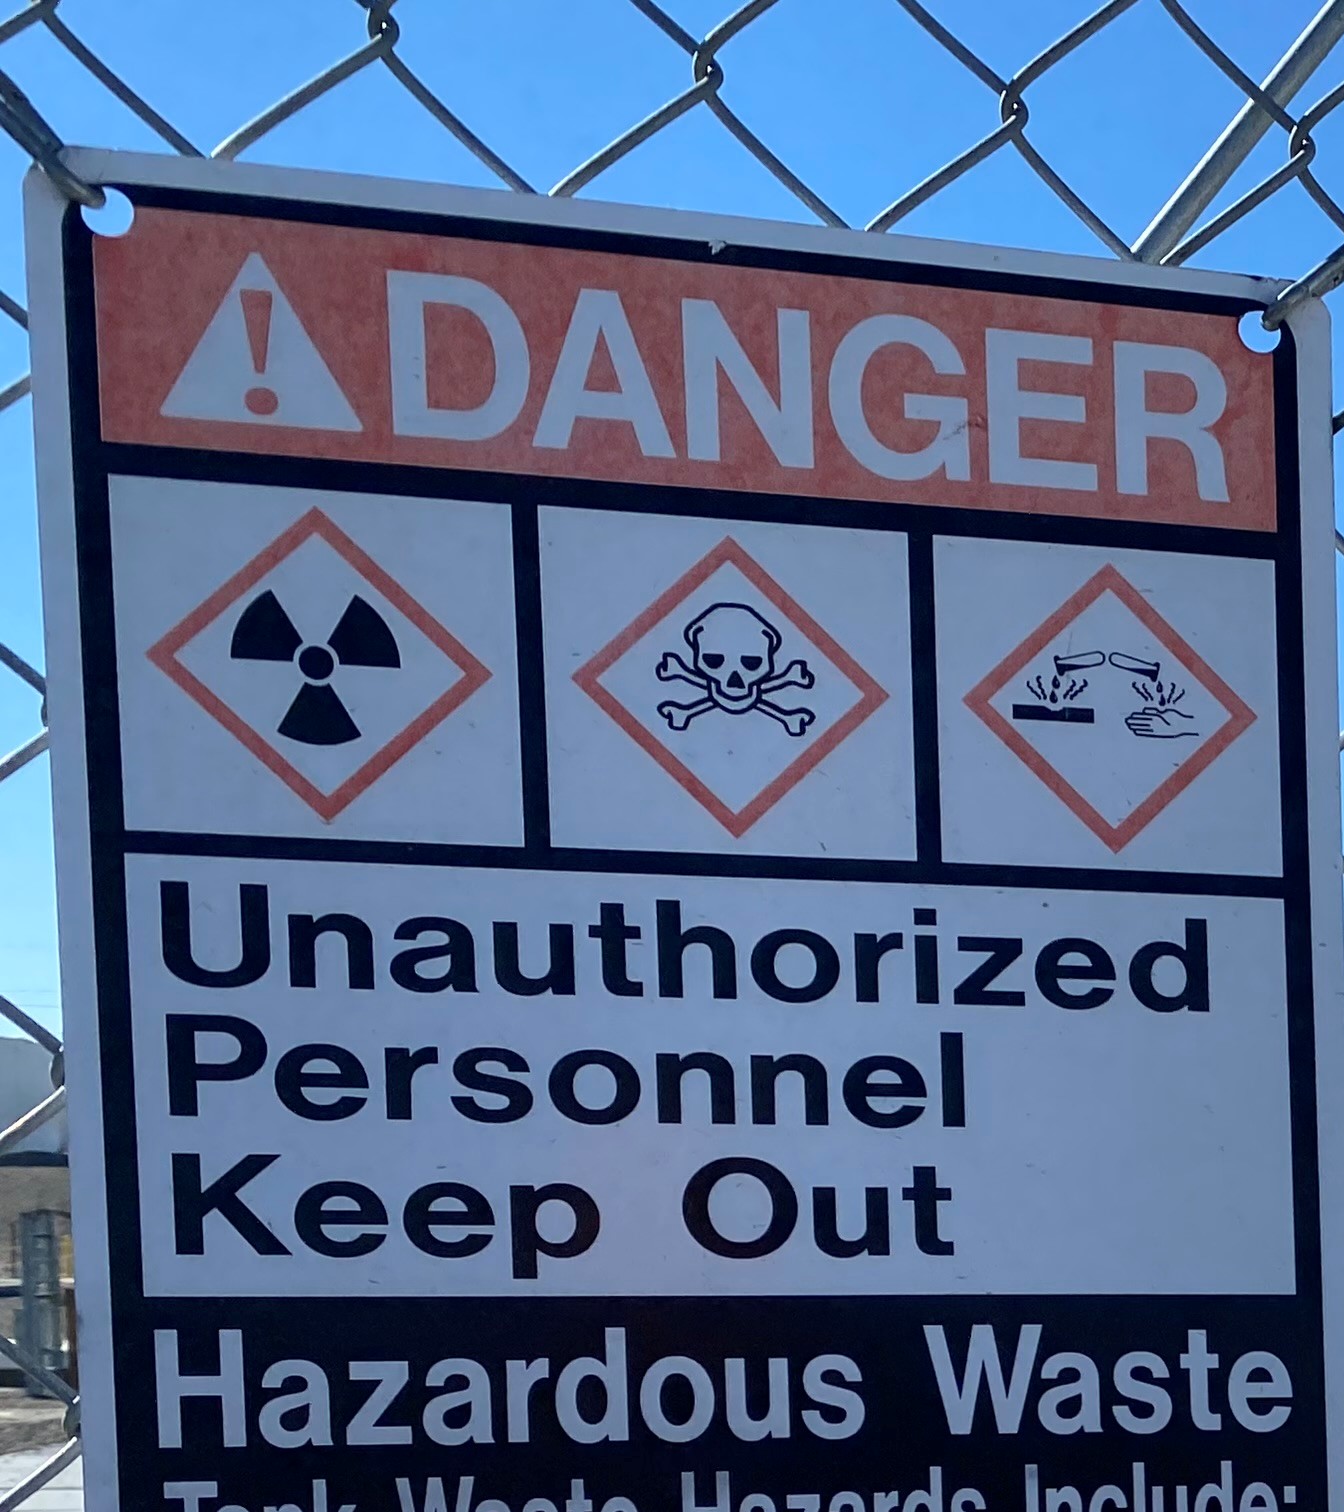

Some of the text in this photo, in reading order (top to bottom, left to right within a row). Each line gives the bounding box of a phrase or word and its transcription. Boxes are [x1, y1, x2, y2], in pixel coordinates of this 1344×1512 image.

[387, 270, 1230, 502] DANGER
[160, 881, 1209, 1012] Unauthorized
[166, 1014, 965, 1128] Personnel
[172, 1153, 954, 1279] Keep Out
[154, 1324, 1293, 1448] Hazardous Waste
